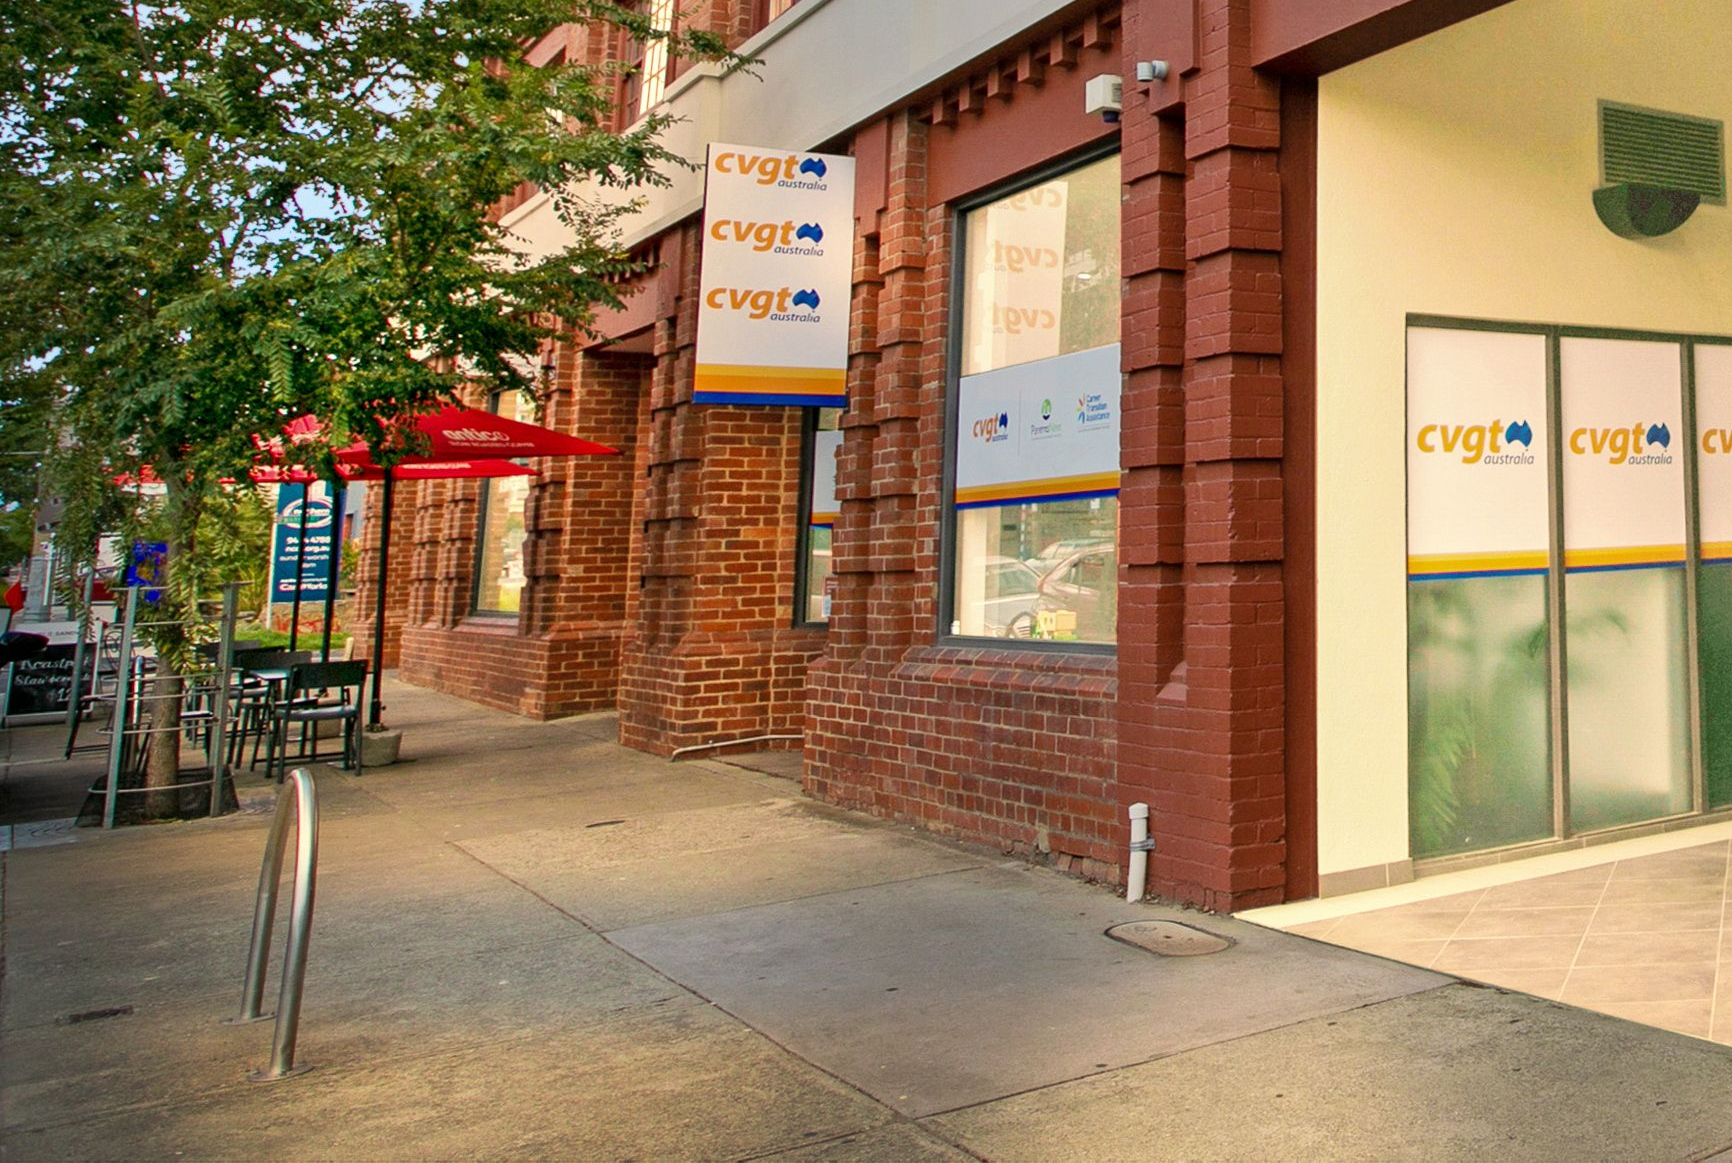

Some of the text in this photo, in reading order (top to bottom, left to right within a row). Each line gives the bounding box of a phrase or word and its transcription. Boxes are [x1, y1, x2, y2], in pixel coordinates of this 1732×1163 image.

[715, 151, 799, 186] cvgt
[777, 178, 828, 192] australia
[710, 218, 796, 252] cvgt
[773, 245, 824, 257] australia
[706, 286, 792, 320] cvgt
[770, 311, 821, 324] australia
[972, 412, 999, 442] cvgt
[1417, 418, 1502, 464] cvgt
[1569, 421, 1647, 465] cvgt
[1484, 451, 1535, 466] australia
[1628, 452, 1673, 466] australia
